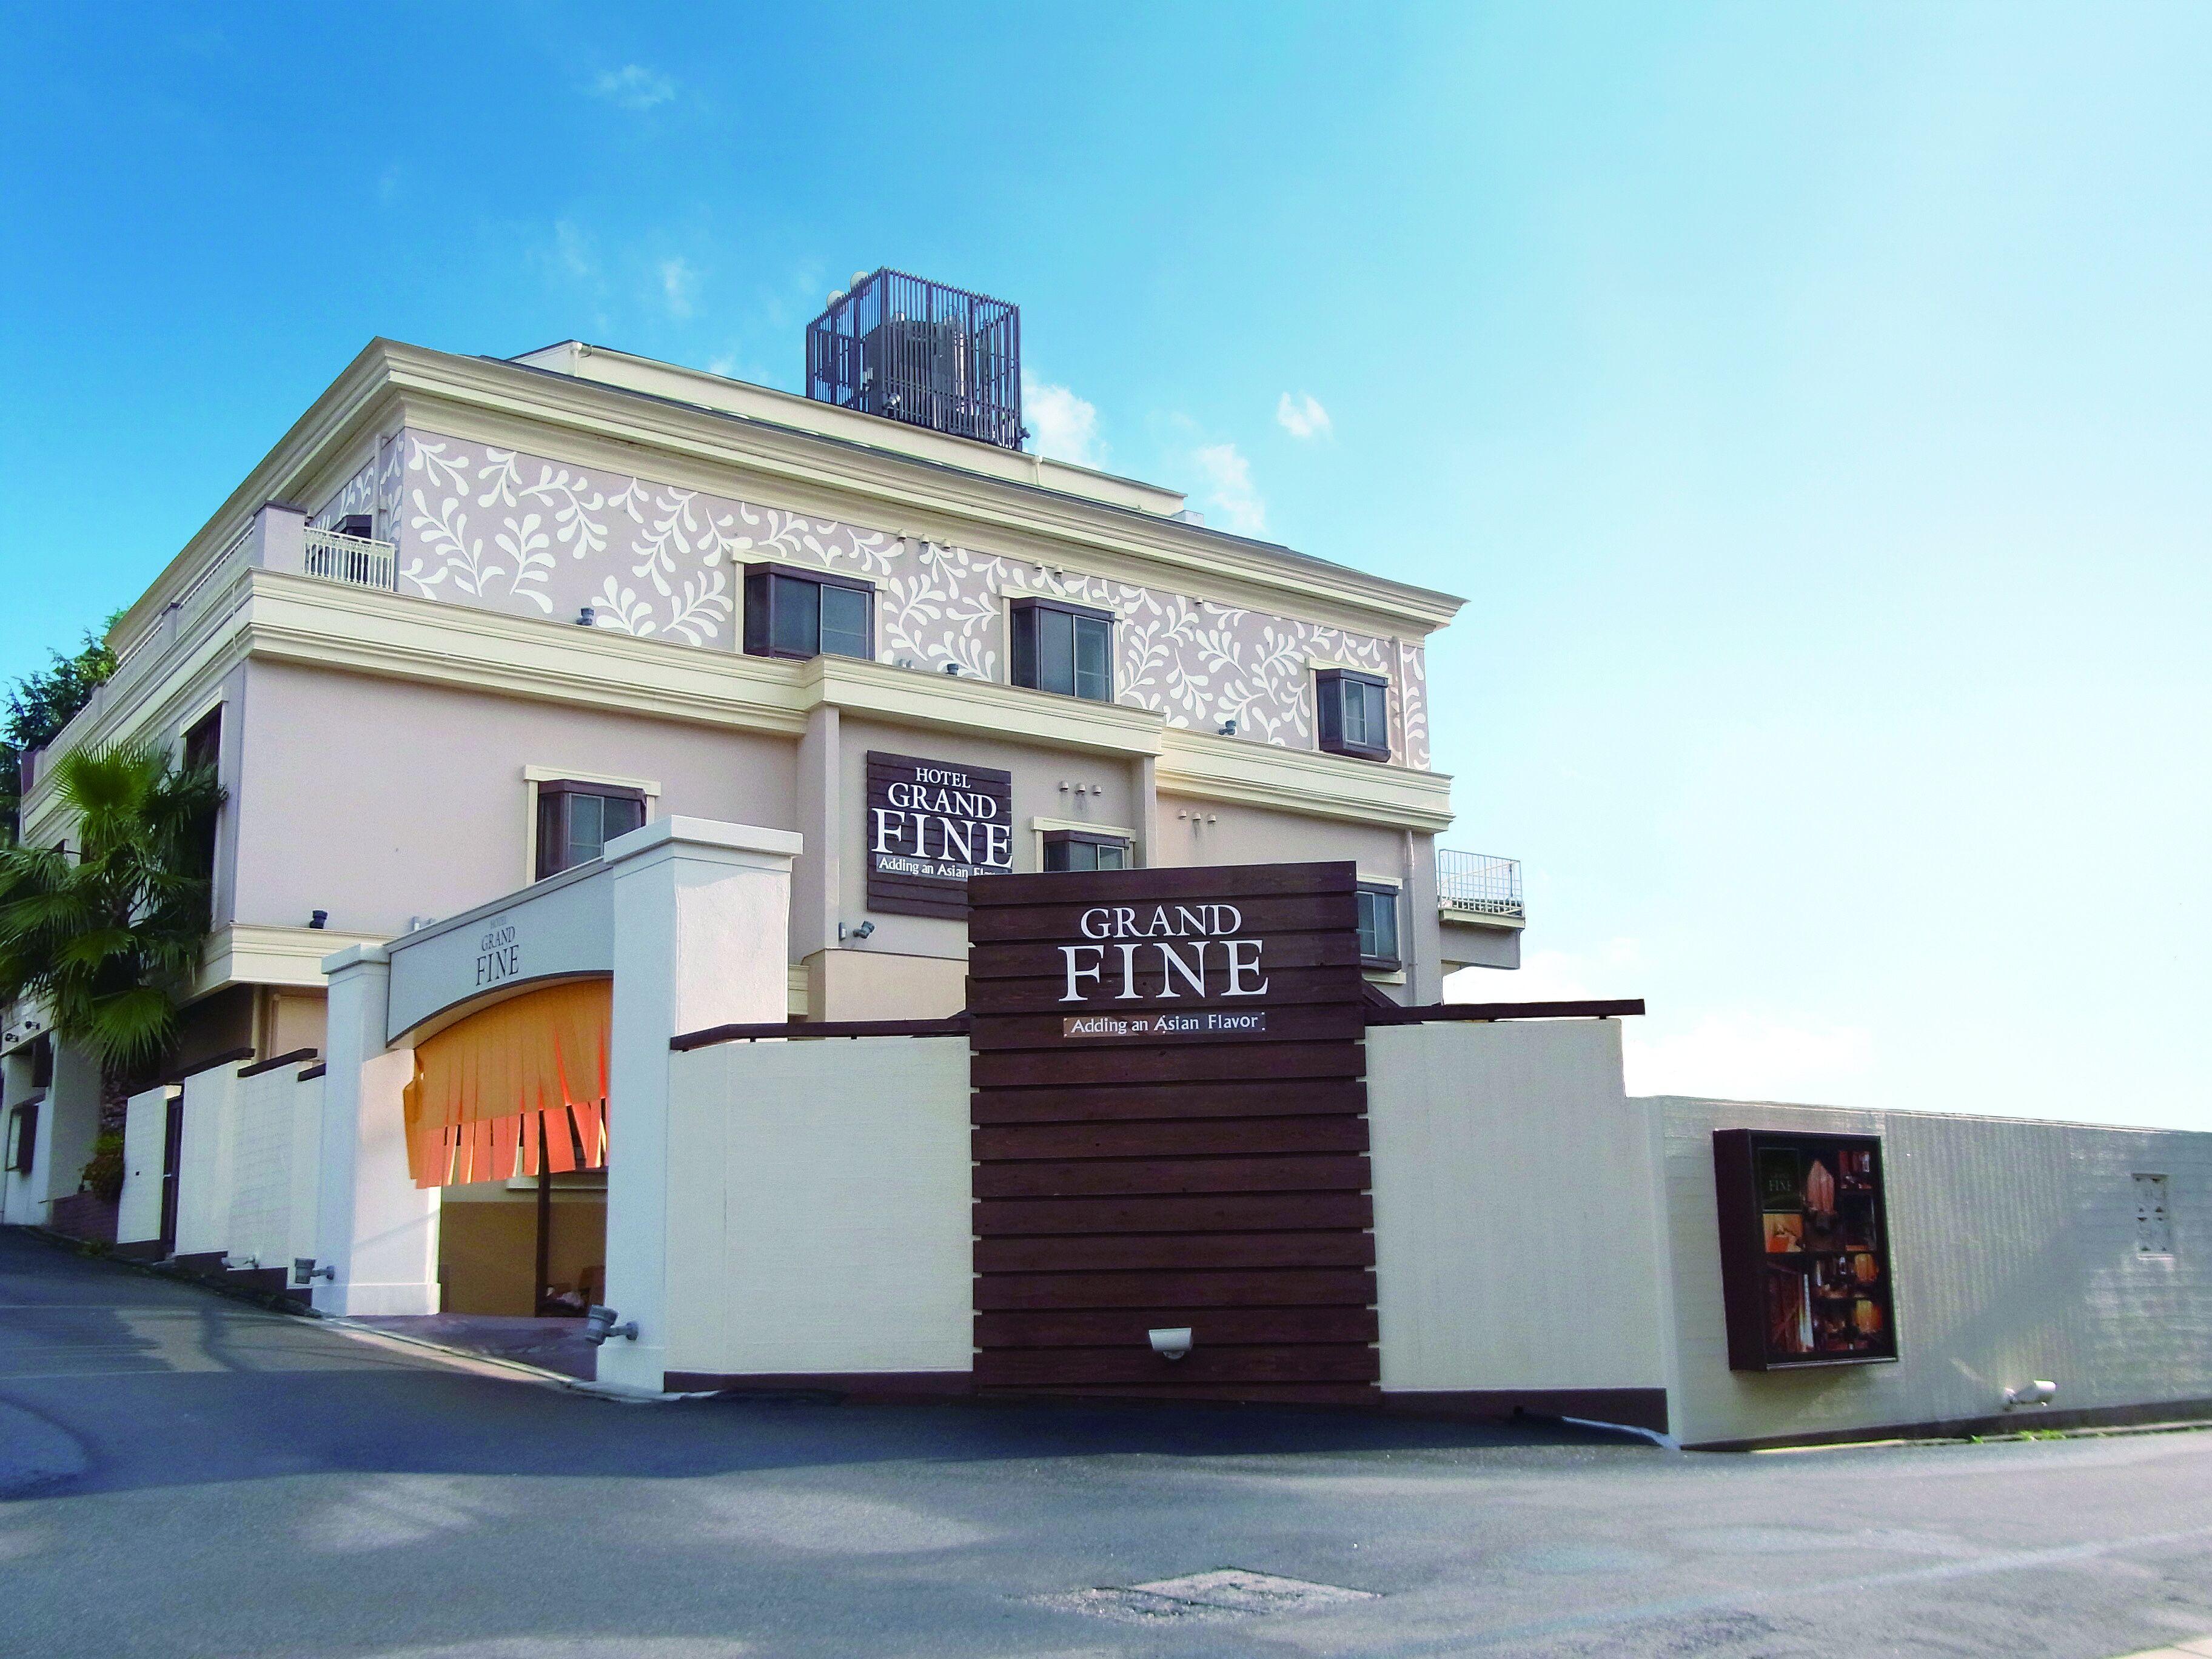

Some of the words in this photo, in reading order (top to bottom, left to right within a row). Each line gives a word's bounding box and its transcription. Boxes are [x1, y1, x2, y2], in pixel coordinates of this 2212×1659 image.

[916, 767, 971, 788] HOTEL
[888, 782, 997, 819] GRAND
[871, 808, 1013, 868] FINE
[879, 857, 919, 875] Adding
[922, 863, 934, 874] an
[937, 863, 968, 878] Asian
[481, 926, 515, 951] GRAND
[1081, 904, 1242, 939] GRAND
[476, 944, 519, 986] FINE
[1057, 939, 1269, 1002] FINE
[1071, 1016, 1128, 1034] Adding
[1131, 1019, 1148, 1031] an
[1154, 1016, 1199, 1031] Asian
[1208, 1014, 1258, 1030] Flavor
